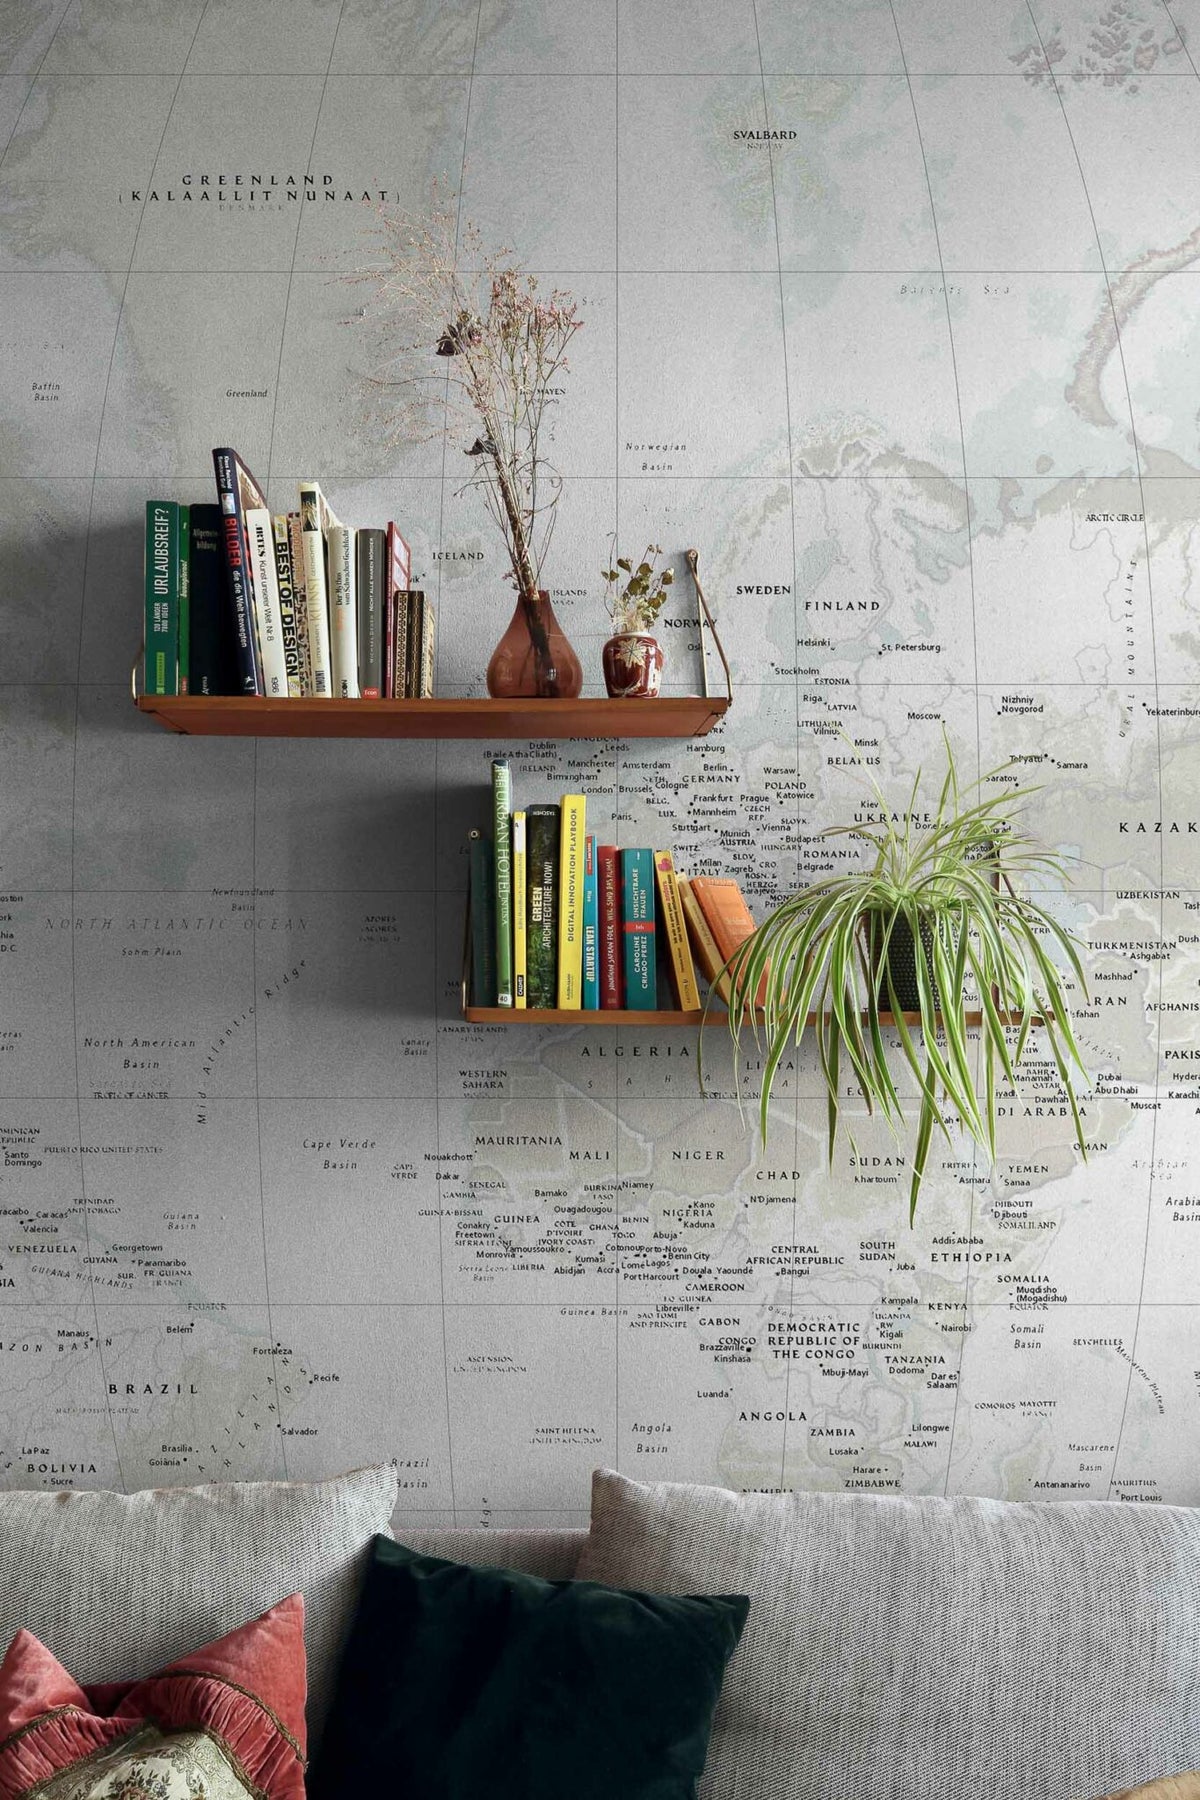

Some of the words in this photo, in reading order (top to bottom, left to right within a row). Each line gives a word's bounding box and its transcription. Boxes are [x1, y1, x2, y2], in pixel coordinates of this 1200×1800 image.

[733, 130, 797, 140] SVALBARD
[182, 175, 333, 185] GREENLAND
[226, 388, 268, 398] Greenland
[625, 443, 688, 453] Norwegian
[642, 462, 674, 471] Basin
[224, 518, 242, 567] BILDER
[154, 508, 169, 595] URLAUBSREIF?
[432, 552, 484, 560] ICELAND
[276, 541, 290, 583] BEST
[736, 586, 791, 595] SWEDEN
[280, 587, 293, 608] OF
[236, 595, 244, 614] Welt
[805, 602, 880, 611] FINLAND
[664, 619, 718, 628] NORWAY
[237, 613, 247, 648] bewegten
[282, 614, 298, 677] DESIGN
[797, 639, 831, 647] Helsinki
[895, 644, 941, 653] Petersburg
[774, 667, 819, 675] Stockholm
[803, 695, 823, 703] Riga
[1002, 696, 1034, 705] Nizhniy
[1002, 705, 1044, 714] Novgorod
[908, 712, 941, 720] Moscow
[686, 745, 726, 753] Hamburg
[567, 760, 616, 768] Manchester
[1056, 761, 1088, 769] Samara
[682, 775, 741, 783] GERMANY
[655, 781, 689, 792] Cologne
[765, 782, 806, 790] POLAND
[740, 795, 769, 803] Prague
[494, 786, 510, 840] URBAN
[693, 808, 737, 816] Mannheim
[854, 813, 931, 822] UKRAINE
[569, 808, 577, 853] PLAYBOOK
[672, 824, 710, 833] Stuttgart
[785, 835, 825, 844] Budapest
[699, 859, 722, 867] Milan
[797, 863, 834, 871] Belgrade
[497, 843, 511, 897] HOTEL
[543, 861, 553, 885] NOW!
[725, 865, 753, 874] Zagreb
[568, 854, 576, 904] INNOVATION
[532, 887, 543, 922] GREEN
[542, 884, 553, 948] ARCHITECTURE
[567, 905, 575, 942] DIGITAL
[585, 926, 595, 946] LEAN
[1087, 942, 1177, 950] TURKMENISTAN
[1130, 952, 1170, 961] Ashgabat
[586, 947, 595, 982] STARTUP
[640, 935, 648, 989] CRIADO-PEREZ
[1094, 973, 1133, 981] Mashhad
[84, 1038, 124, 1048] North
[131, 1038, 196, 1048] American
[581, 1046, 690, 1057] ALGERIA
[123, 1059, 160, 1070] Basin
[462, 1081, 504, 1089] SAHARA
[1130, 1102, 1161, 1110] Muscat
[475, 1136, 562, 1145] MAURITANIA
[302, 1139, 332, 1152] Cape
[340, 1139, 376, 1150] Verde
[569, 1151, 609, 1160] MALI
[672, 1151, 725, 1160] NIGER
[323, 1160, 357, 1170] Basin
[849, 1157, 905, 1166] SUDAN
[756, 1171, 800, 1180] CHAD
[622, 1181, 654, 1190] Niamey
[693, 1201, 715, 1209] Kano
[494, 1215, 540, 1223] GUINEA
[8, 1245, 77, 1253] VENEZUELA
[771, 1246, 819, 1254] CENTRAL
[860, 1241, 896, 1250] SOUTH
[746, 1256, 791, 1265] AFRICAN
[794, 1256, 845, 1265] REPUBLIC
[860, 1253, 896, 1261] SUDAN
[931, 1253, 1012, 1263] ETHIOPIA
[682, 1267, 712, 1275] Douala
[780, 1267, 810, 1276] Bangui
[623, 1273, 642, 1281] Port
[643, 1273, 680, 1281] Harcourt
[997, 1275, 1050, 1283] SOMALIA
[881, 1296, 919, 1305] Kampala
[928, 1303, 968, 1311] KENYA
[699, 1318, 740, 1326] GABON
[768, 1323, 860, 1332] DEMOCRATIC
[941, 1324, 972, 1332] Nairobi
[57, 1330, 90, 1338] Manaus
[768, 1336, 839, 1346] REPUBLIC
[843, 1336, 860, 1346] OF
[773, 1350, 800, 1359] THE
[805, 1350, 855, 1359] CONGO
[885, 1356, 945, 1365] TANZANIA
[889, 1366, 925, 1375] Dodoma
[313, 1373, 340, 1382] Recife
[109, 1384, 198, 1394] BRAZIL
[697, 1390, 729, 1398] Luanda
[739, 1412, 807, 1422] ANGOLA
[281, 1427, 318, 1436] Salvador
[810, 1428, 856, 1437] ZAMBIA
[829, 1448, 859, 1456] Lusaka
[27, 1464, 97, 1473] BOLIVIA
[845, 1479, 901, 1488] ZIMBABWE
[1120, 1493, 1139, 1502] Port
[1140, 1493, 1162, 1502] Louis
